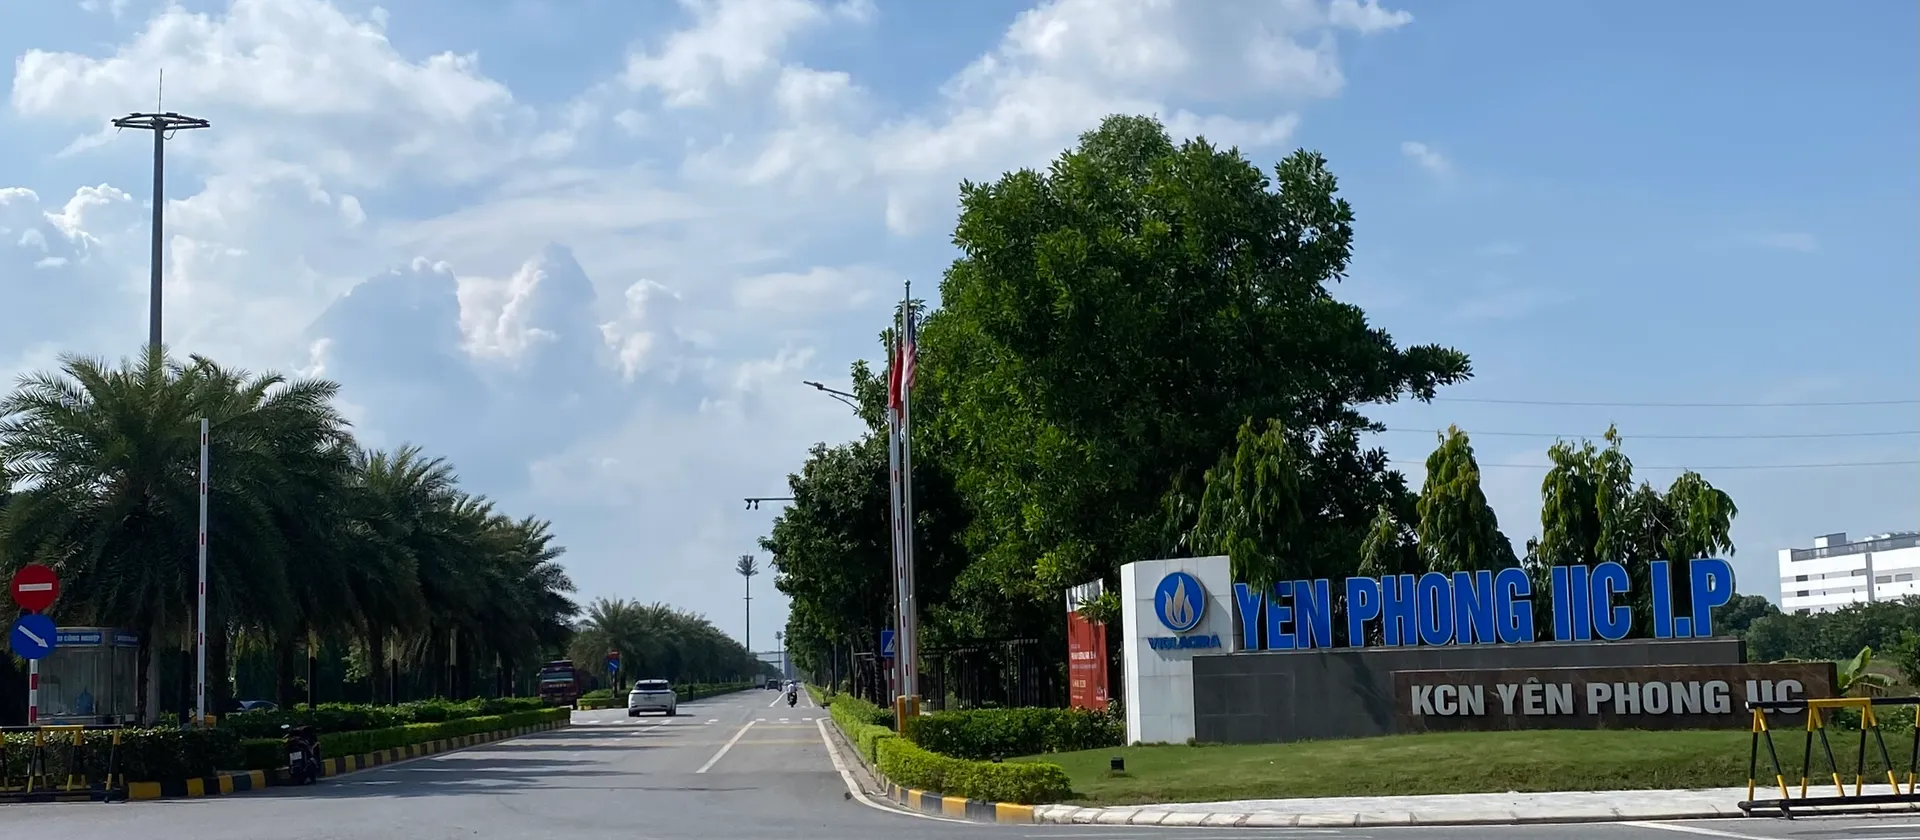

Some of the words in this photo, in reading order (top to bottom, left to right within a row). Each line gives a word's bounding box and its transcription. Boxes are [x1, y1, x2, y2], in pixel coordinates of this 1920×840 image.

[1233, 578, 1332, 650] YEN
[1345, 568, 1535, 647] PHONG
[1551, 561, 1632, 641] IIC
[1650, 558, 1734, 639] I.P
[1411, 684, 1485, 716] KCN
[1497, 676, 1574, 716] YÊN
[1586, 679, 1731, 715] PHONG
[1745, 679, 1804, 714] IIC
